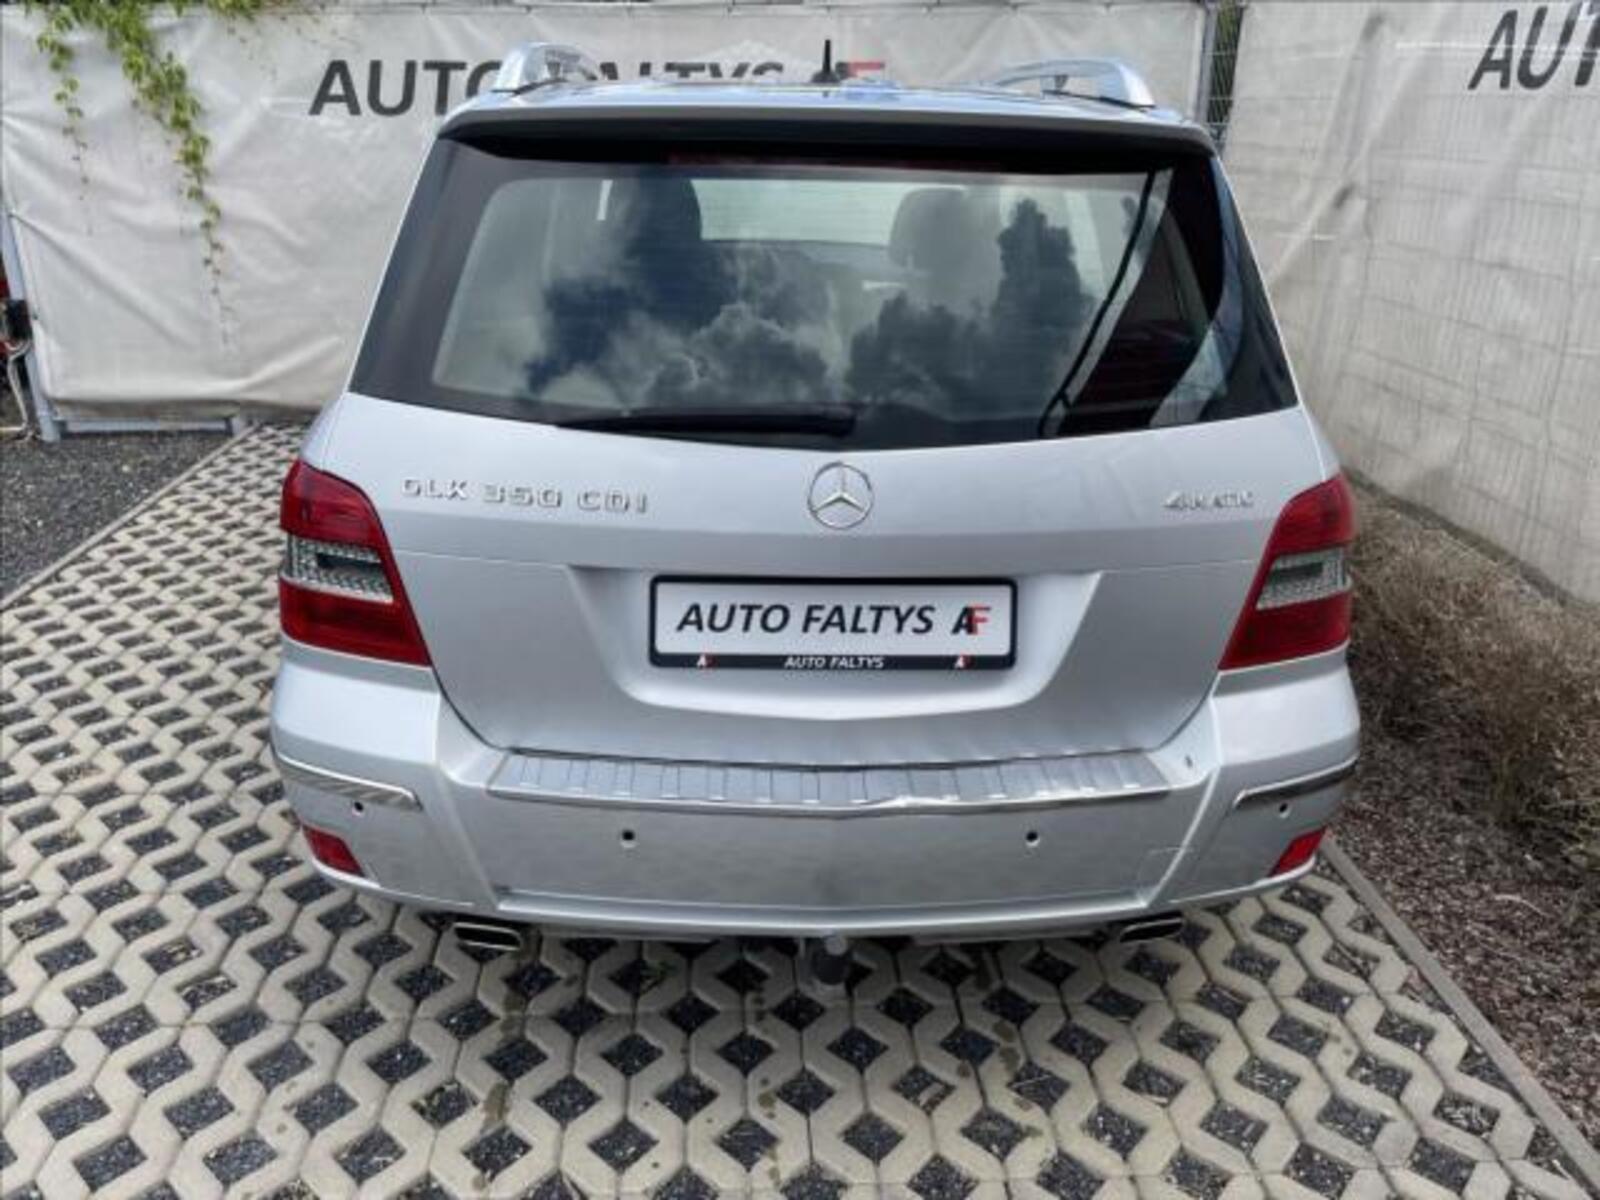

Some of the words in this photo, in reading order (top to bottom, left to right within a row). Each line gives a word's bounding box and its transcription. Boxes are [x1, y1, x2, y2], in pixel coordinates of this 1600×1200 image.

[482, 484, 562, 508] 350
[577, 489, 647, 513] CDI
[676, 602, 790, 633] AUTO
[802, 604, 935, 634] FALTYS
[784, 656, 826, 668] AUTO
[829, 656, 884, 669] FALTYS
